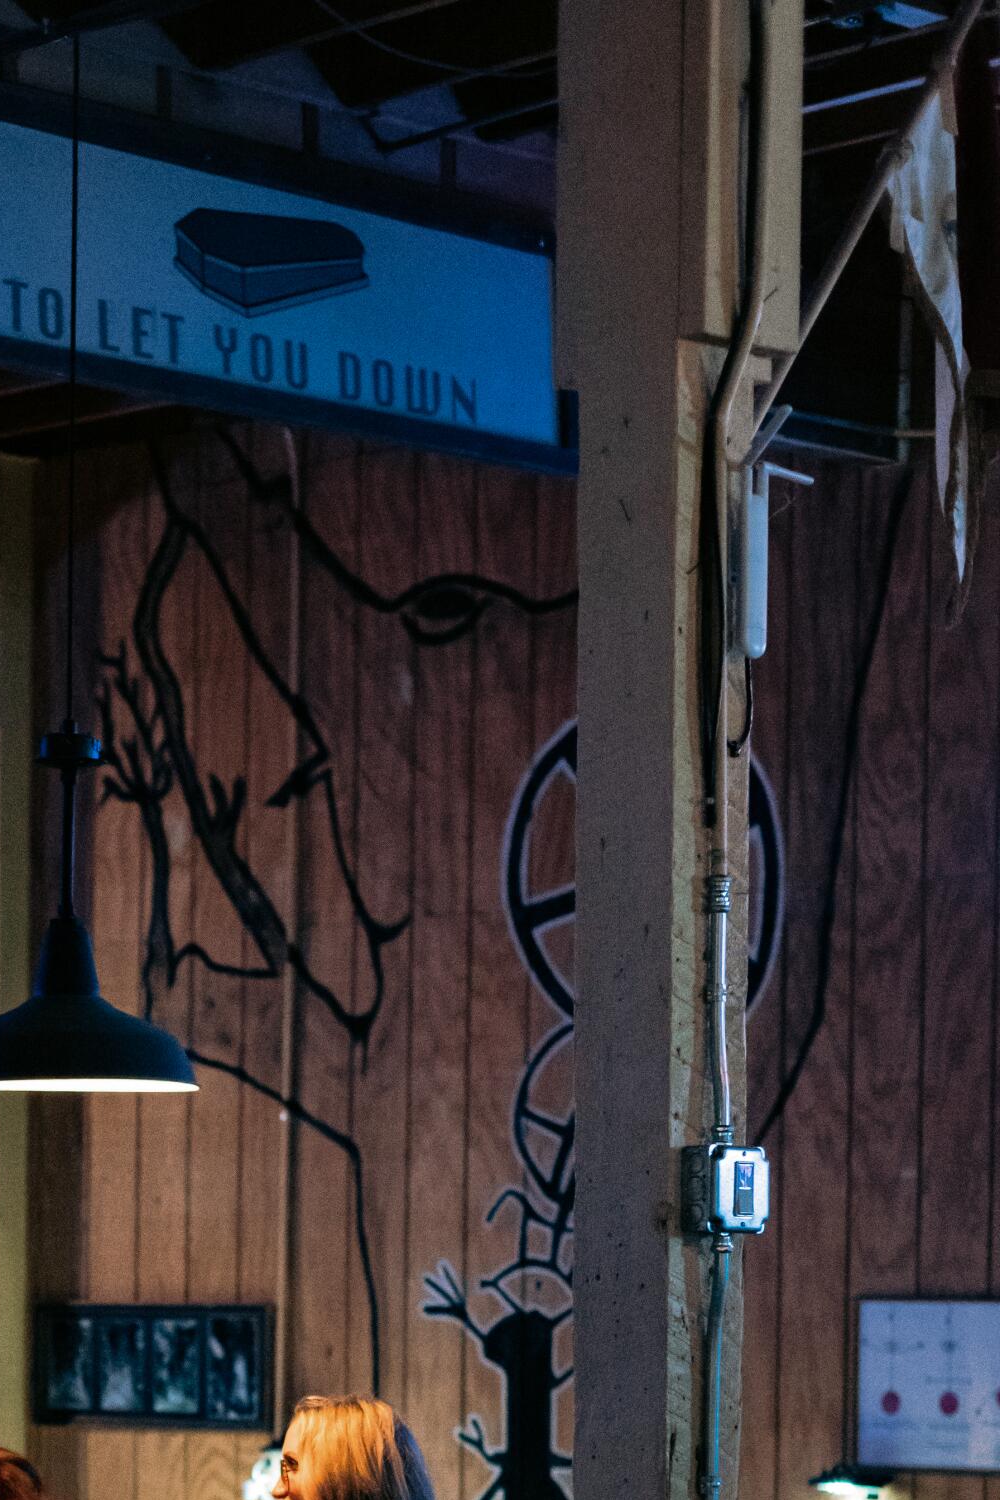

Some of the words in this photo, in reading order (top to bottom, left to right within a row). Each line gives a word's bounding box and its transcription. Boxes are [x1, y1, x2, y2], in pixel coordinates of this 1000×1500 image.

[3, 277, 65, 341] TO
[98, 299, 185, 365] LET
[212, 323, 309, 391] YOU
[339, 350, 478, 424] DOWN
